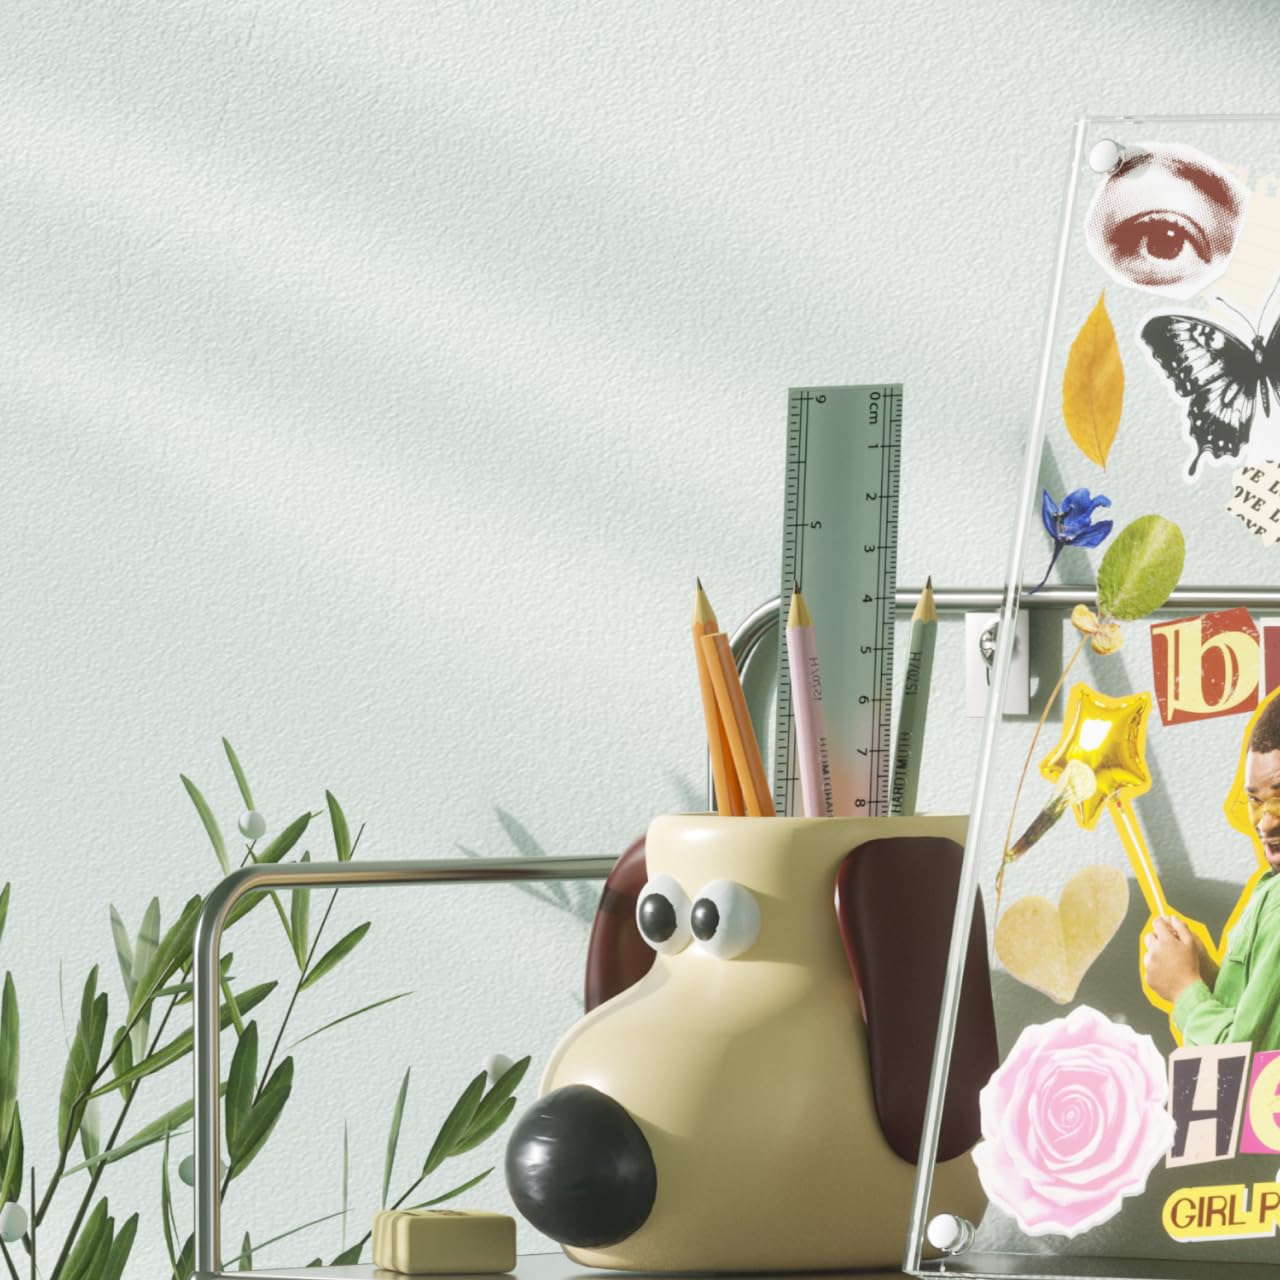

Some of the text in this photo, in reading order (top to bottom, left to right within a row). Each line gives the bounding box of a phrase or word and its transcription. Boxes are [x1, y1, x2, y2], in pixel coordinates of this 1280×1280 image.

[865, 492, 877, 501] 2
[864, 544, 875, 553] 3
[861, 594, 873, 603] 4
[860, 646, 872, 654] 5
[858, 695, 869, 705] 6
[857, 748, 868, 756] 7
[890, 731, 911, 814] HARDTMUTH
[855, 798, 866, 807] 8
[1170, 1194, 1246, 1229] GIRL
